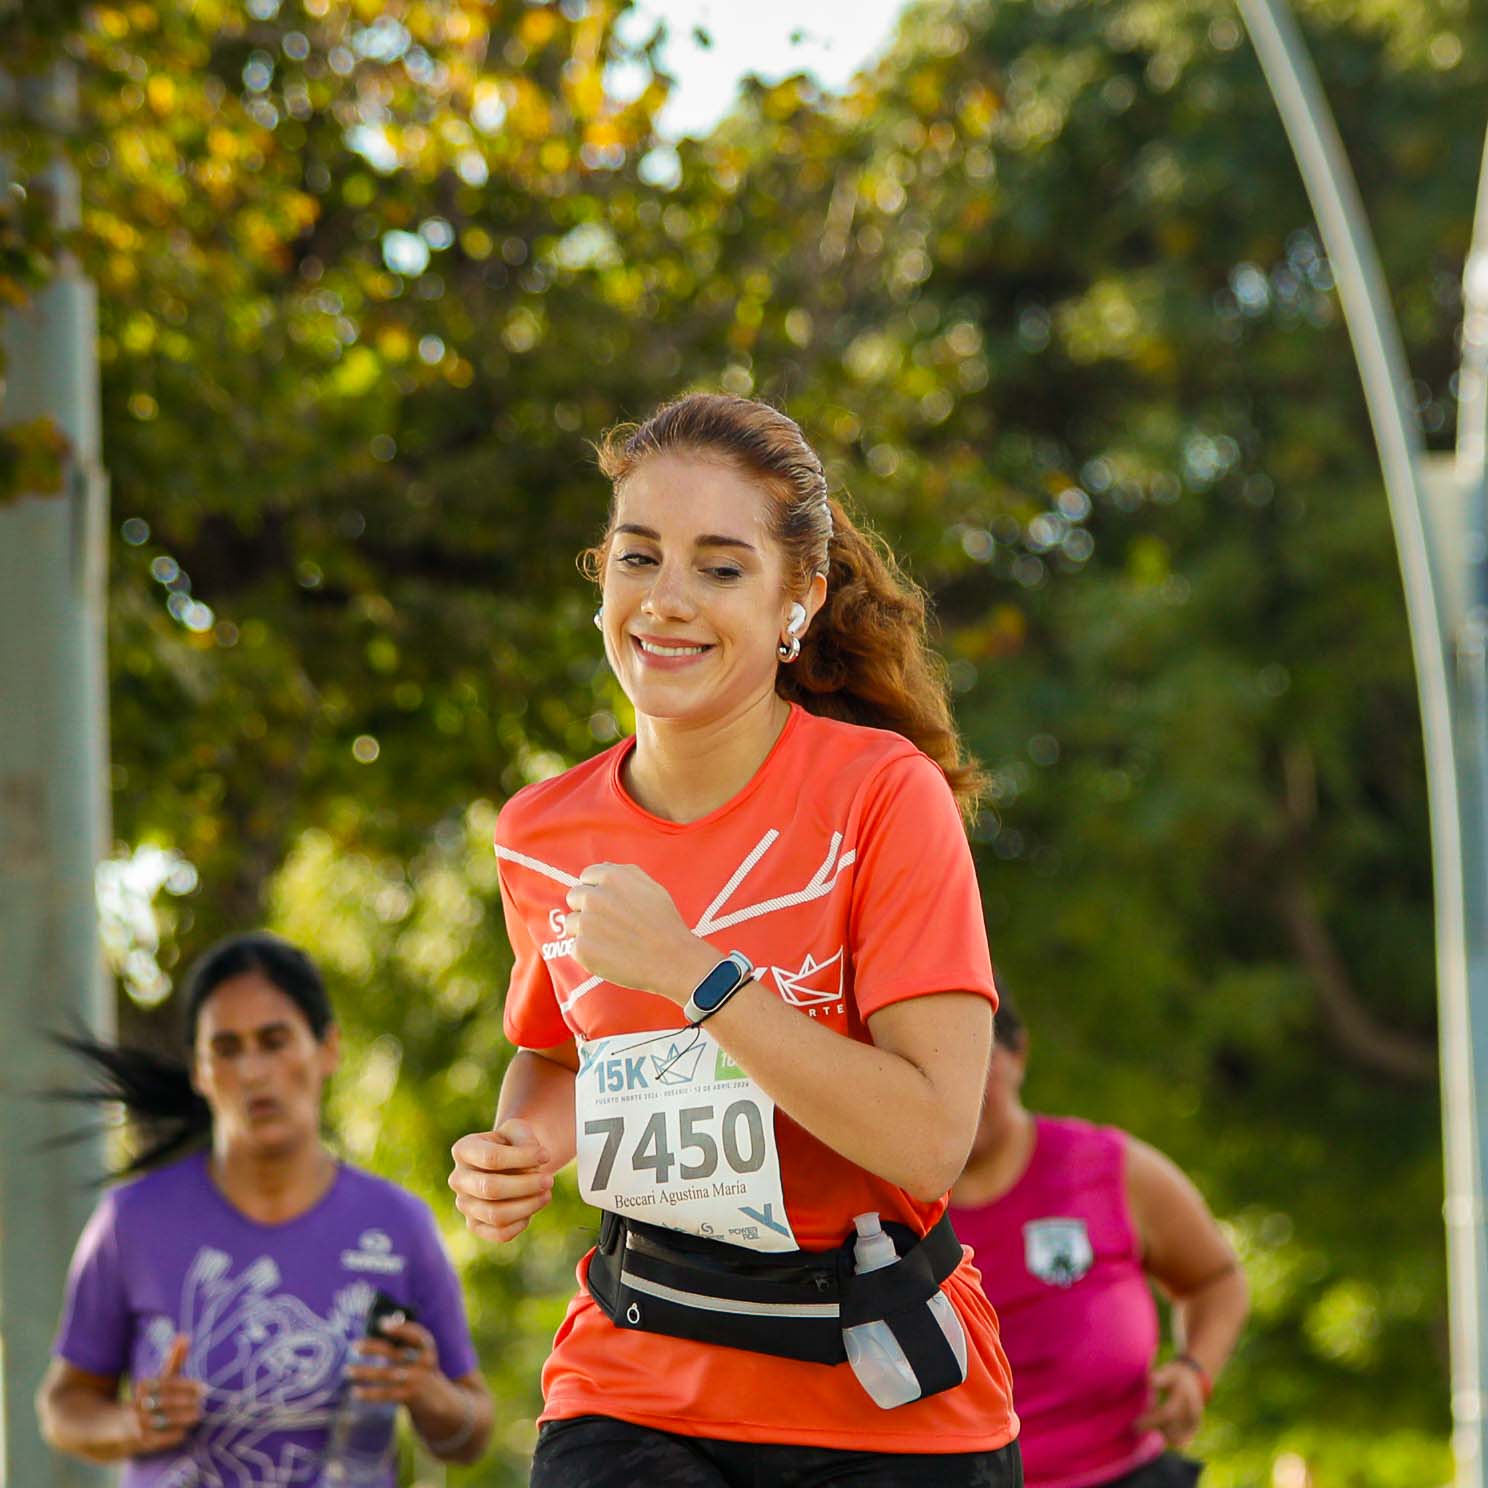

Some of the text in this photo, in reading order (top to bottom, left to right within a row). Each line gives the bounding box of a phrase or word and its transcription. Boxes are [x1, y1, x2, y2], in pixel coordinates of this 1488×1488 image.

[594, 1056, 649, 1093] 15K
[584, 1099, 766, 1192] 7450
[614, 1190, 657, 1209] Beccari
[658, 1185, 710, 1206] Agustina
